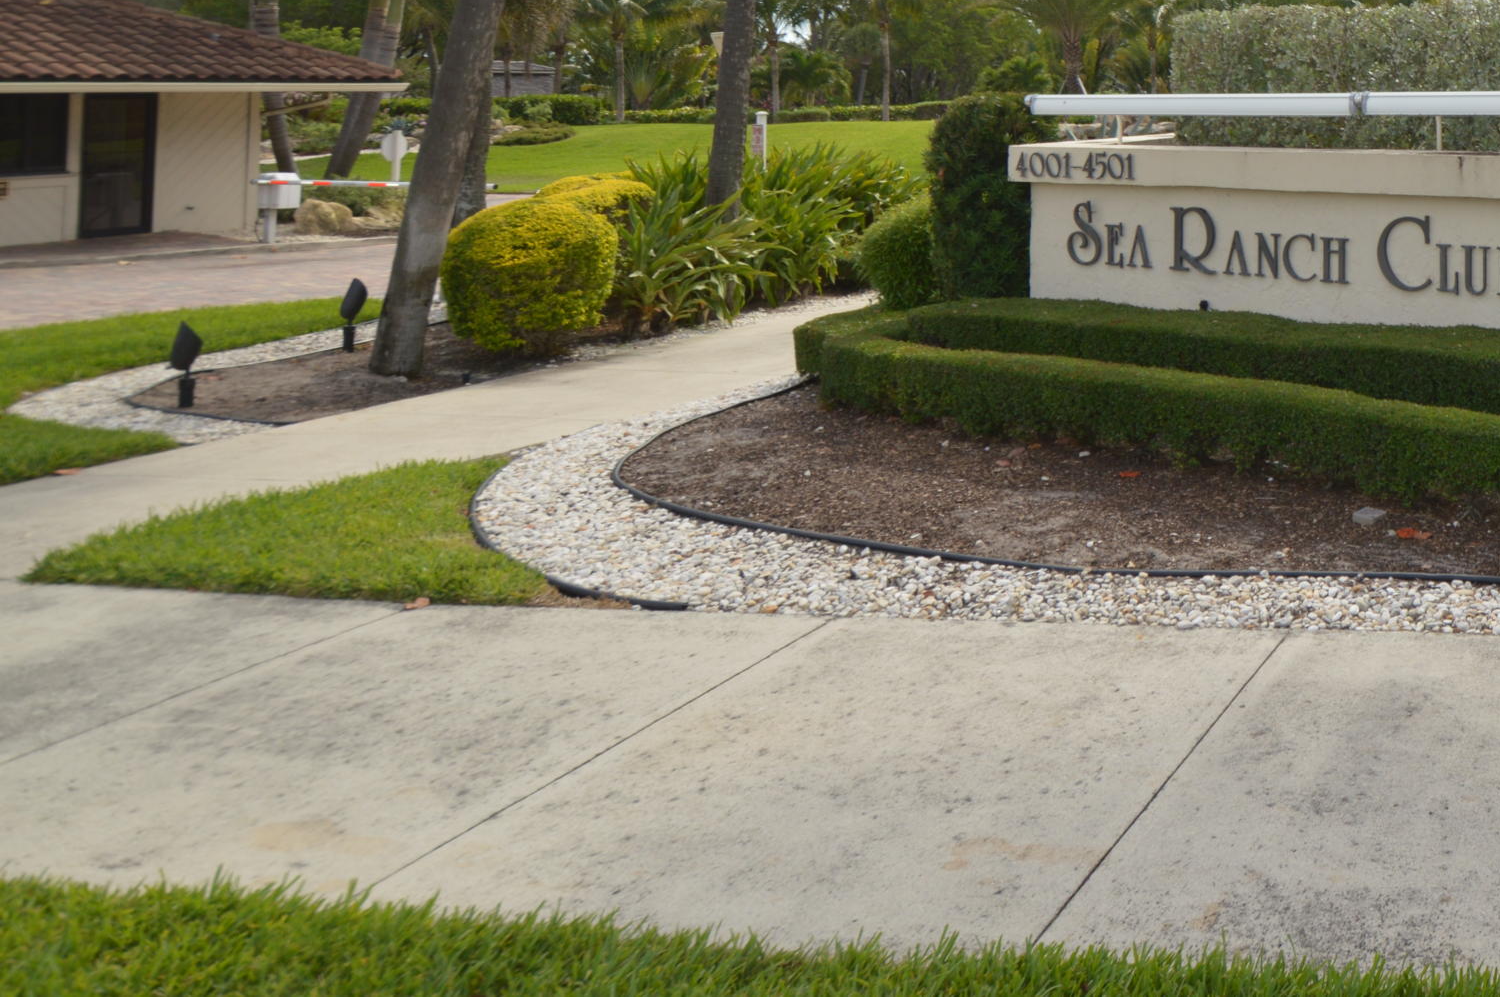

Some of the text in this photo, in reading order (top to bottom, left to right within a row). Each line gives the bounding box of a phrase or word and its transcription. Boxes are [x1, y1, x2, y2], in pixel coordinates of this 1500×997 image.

[1015, 151, 1136, 181] 4001-4501
[1066, 201, 1153, 269] SEA
[1168, 206, 1350, 285] RANCH
